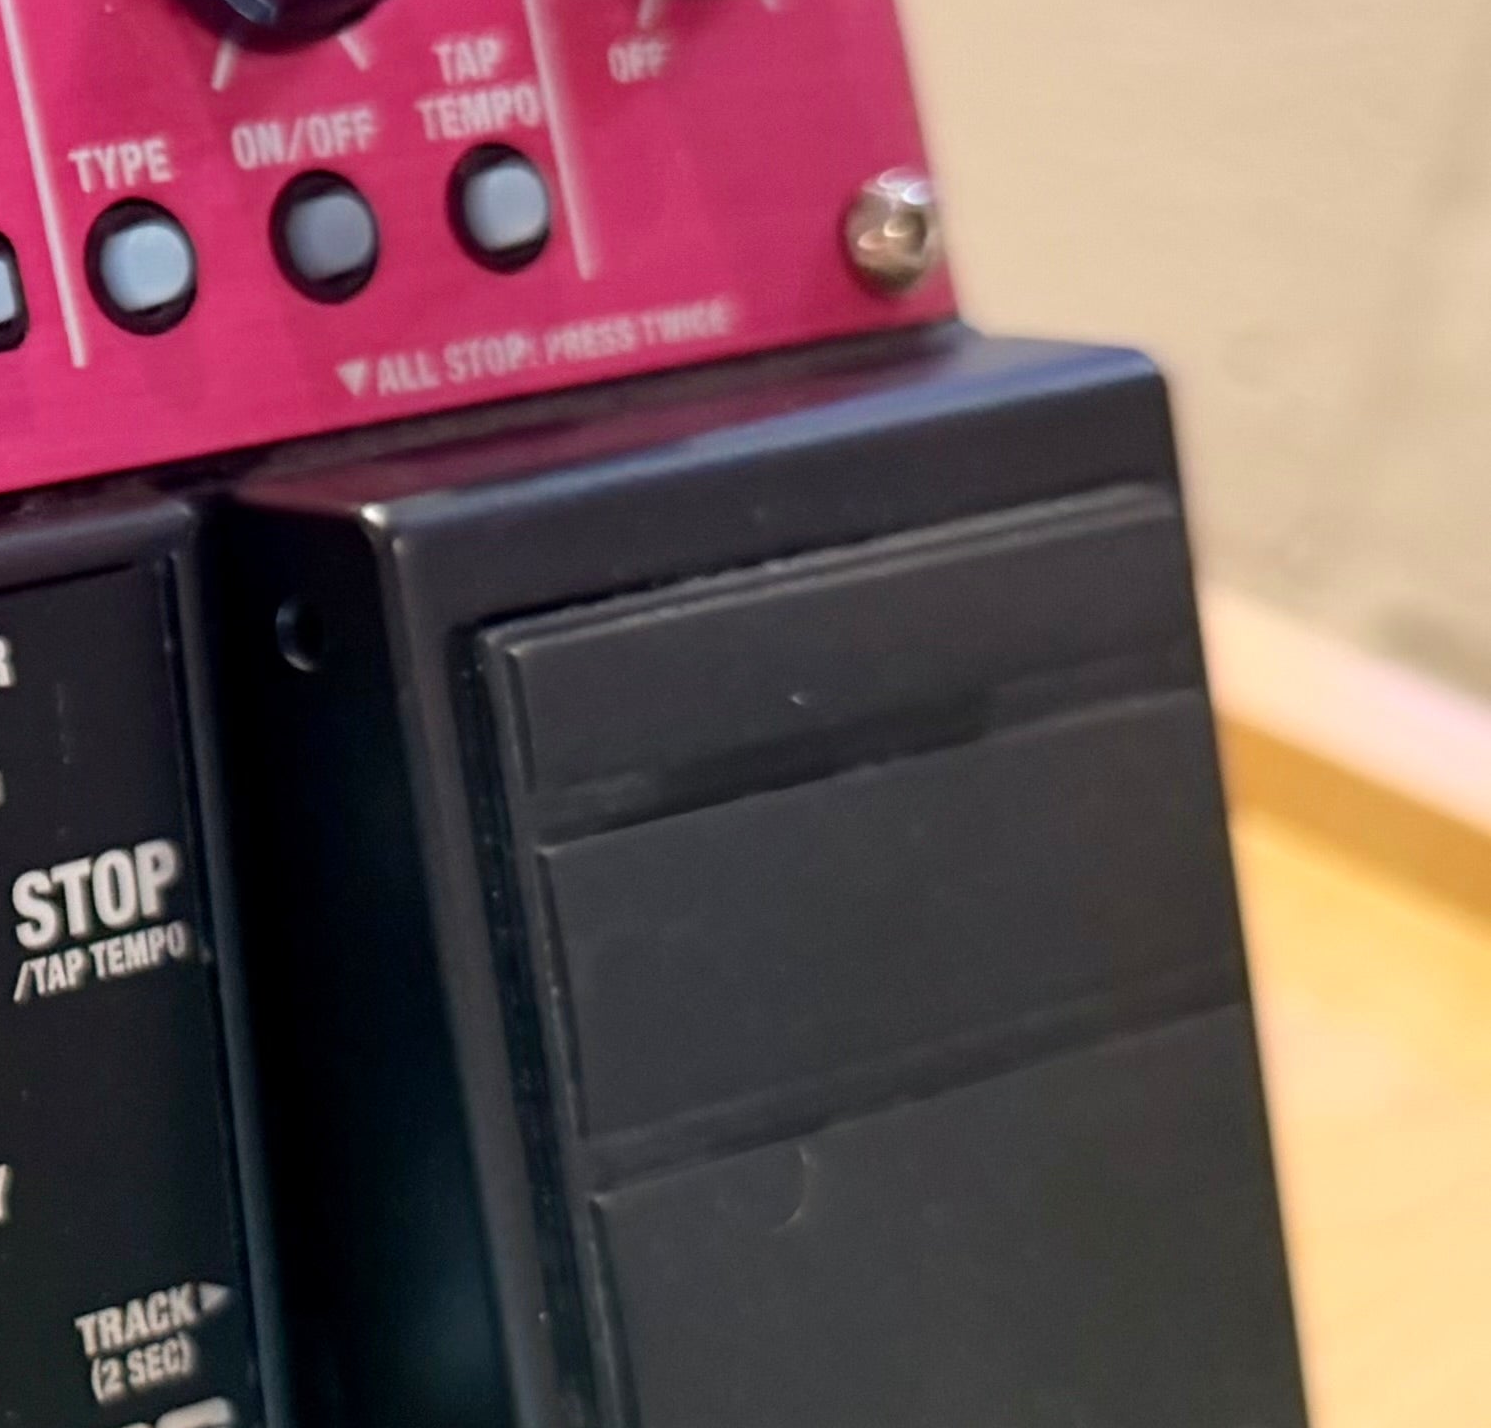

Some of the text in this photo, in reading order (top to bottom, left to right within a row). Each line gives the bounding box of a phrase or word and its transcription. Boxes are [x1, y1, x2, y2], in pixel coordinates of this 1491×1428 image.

[431, 37, 503, 84] TAP
[608, 40, 670, 84] OFF
[231, 107, 377, 171] ON/OFF
[416, 84, 542, 142] TEMPO
[69, 138, 173, 194] TYPE
[376, 297, 733, 398] ALL STOP: PRESS TWICE
[13, 839, 182, 951] STOP
[14, 922, 188, 1003] /TAP TEMPO
[75, 1282, 201, 1356] TRACK
[91, 1334, 196, 1404] (2 SEC)
